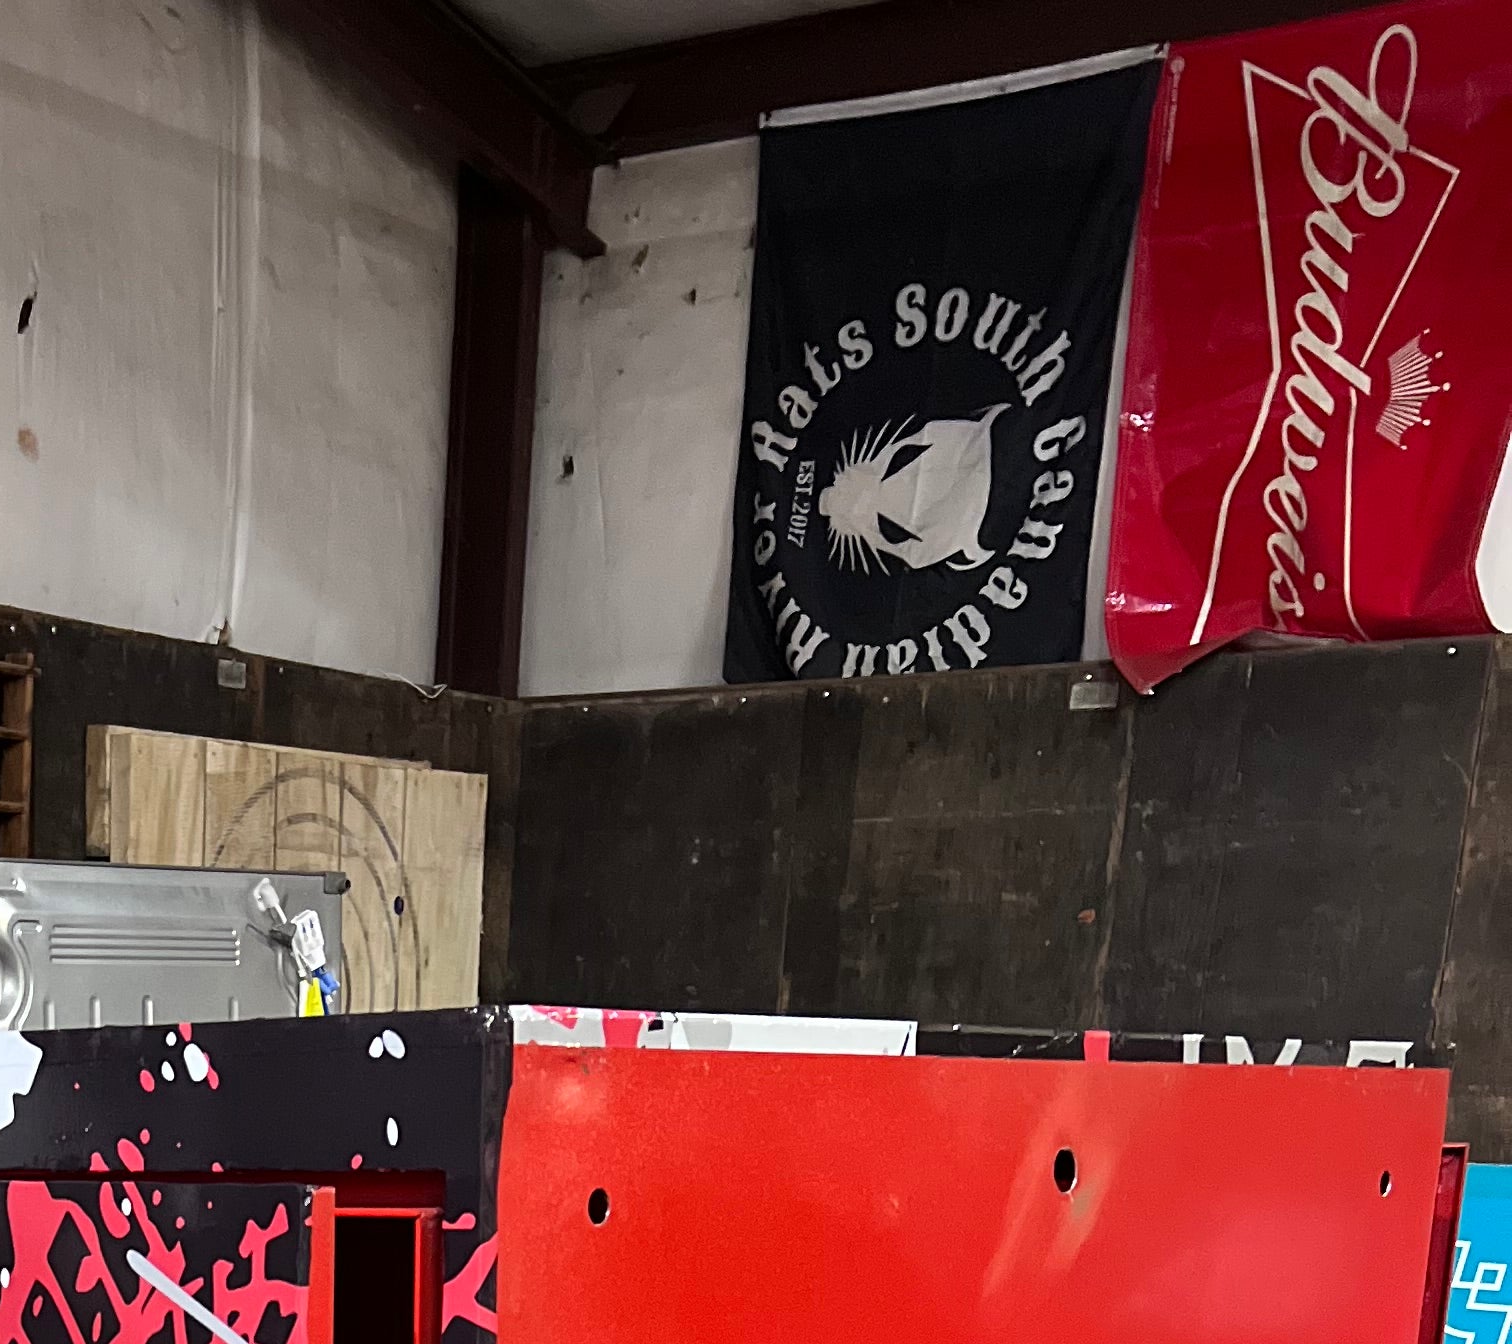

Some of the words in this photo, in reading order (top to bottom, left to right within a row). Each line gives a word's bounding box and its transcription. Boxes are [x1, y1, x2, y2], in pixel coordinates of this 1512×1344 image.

[751, 319, 874, 472] Rats
[894, 283, 1072, 407] South
[840, 415, 1087, 680] Canadian
